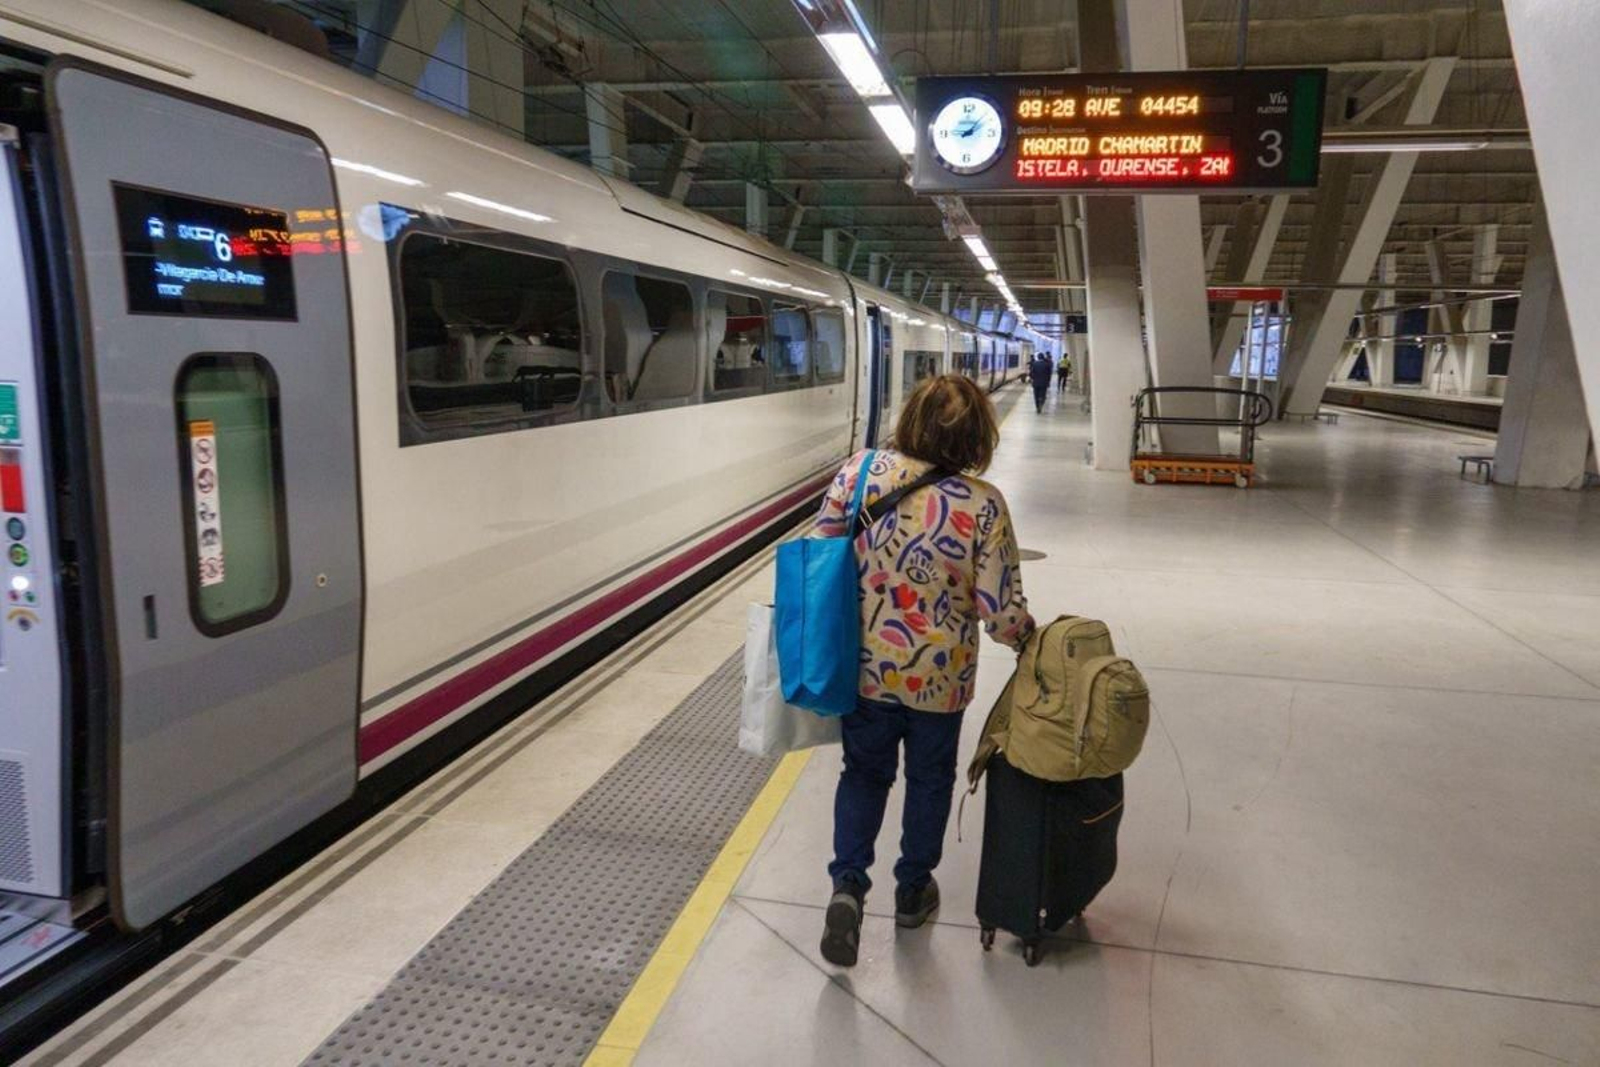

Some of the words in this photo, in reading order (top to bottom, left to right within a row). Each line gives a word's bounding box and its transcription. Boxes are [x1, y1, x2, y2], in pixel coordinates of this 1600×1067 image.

[963, 104, 976, 113] 12
[1019, 99, 1076, 118] 09:28
[1085, 97, 1121, 116] AVE
[1140, 95, 1199, 116] 04454
[940, 129, 949, 139] 9
[1023, 137, 1090, 157] MADRID
[1099, 135, 1203, 155] CHAMARTIN
[1257, 129, 1283, 168] 3
[962, 153, 972, 163] 6
[215, 232, 232, 262] 6
